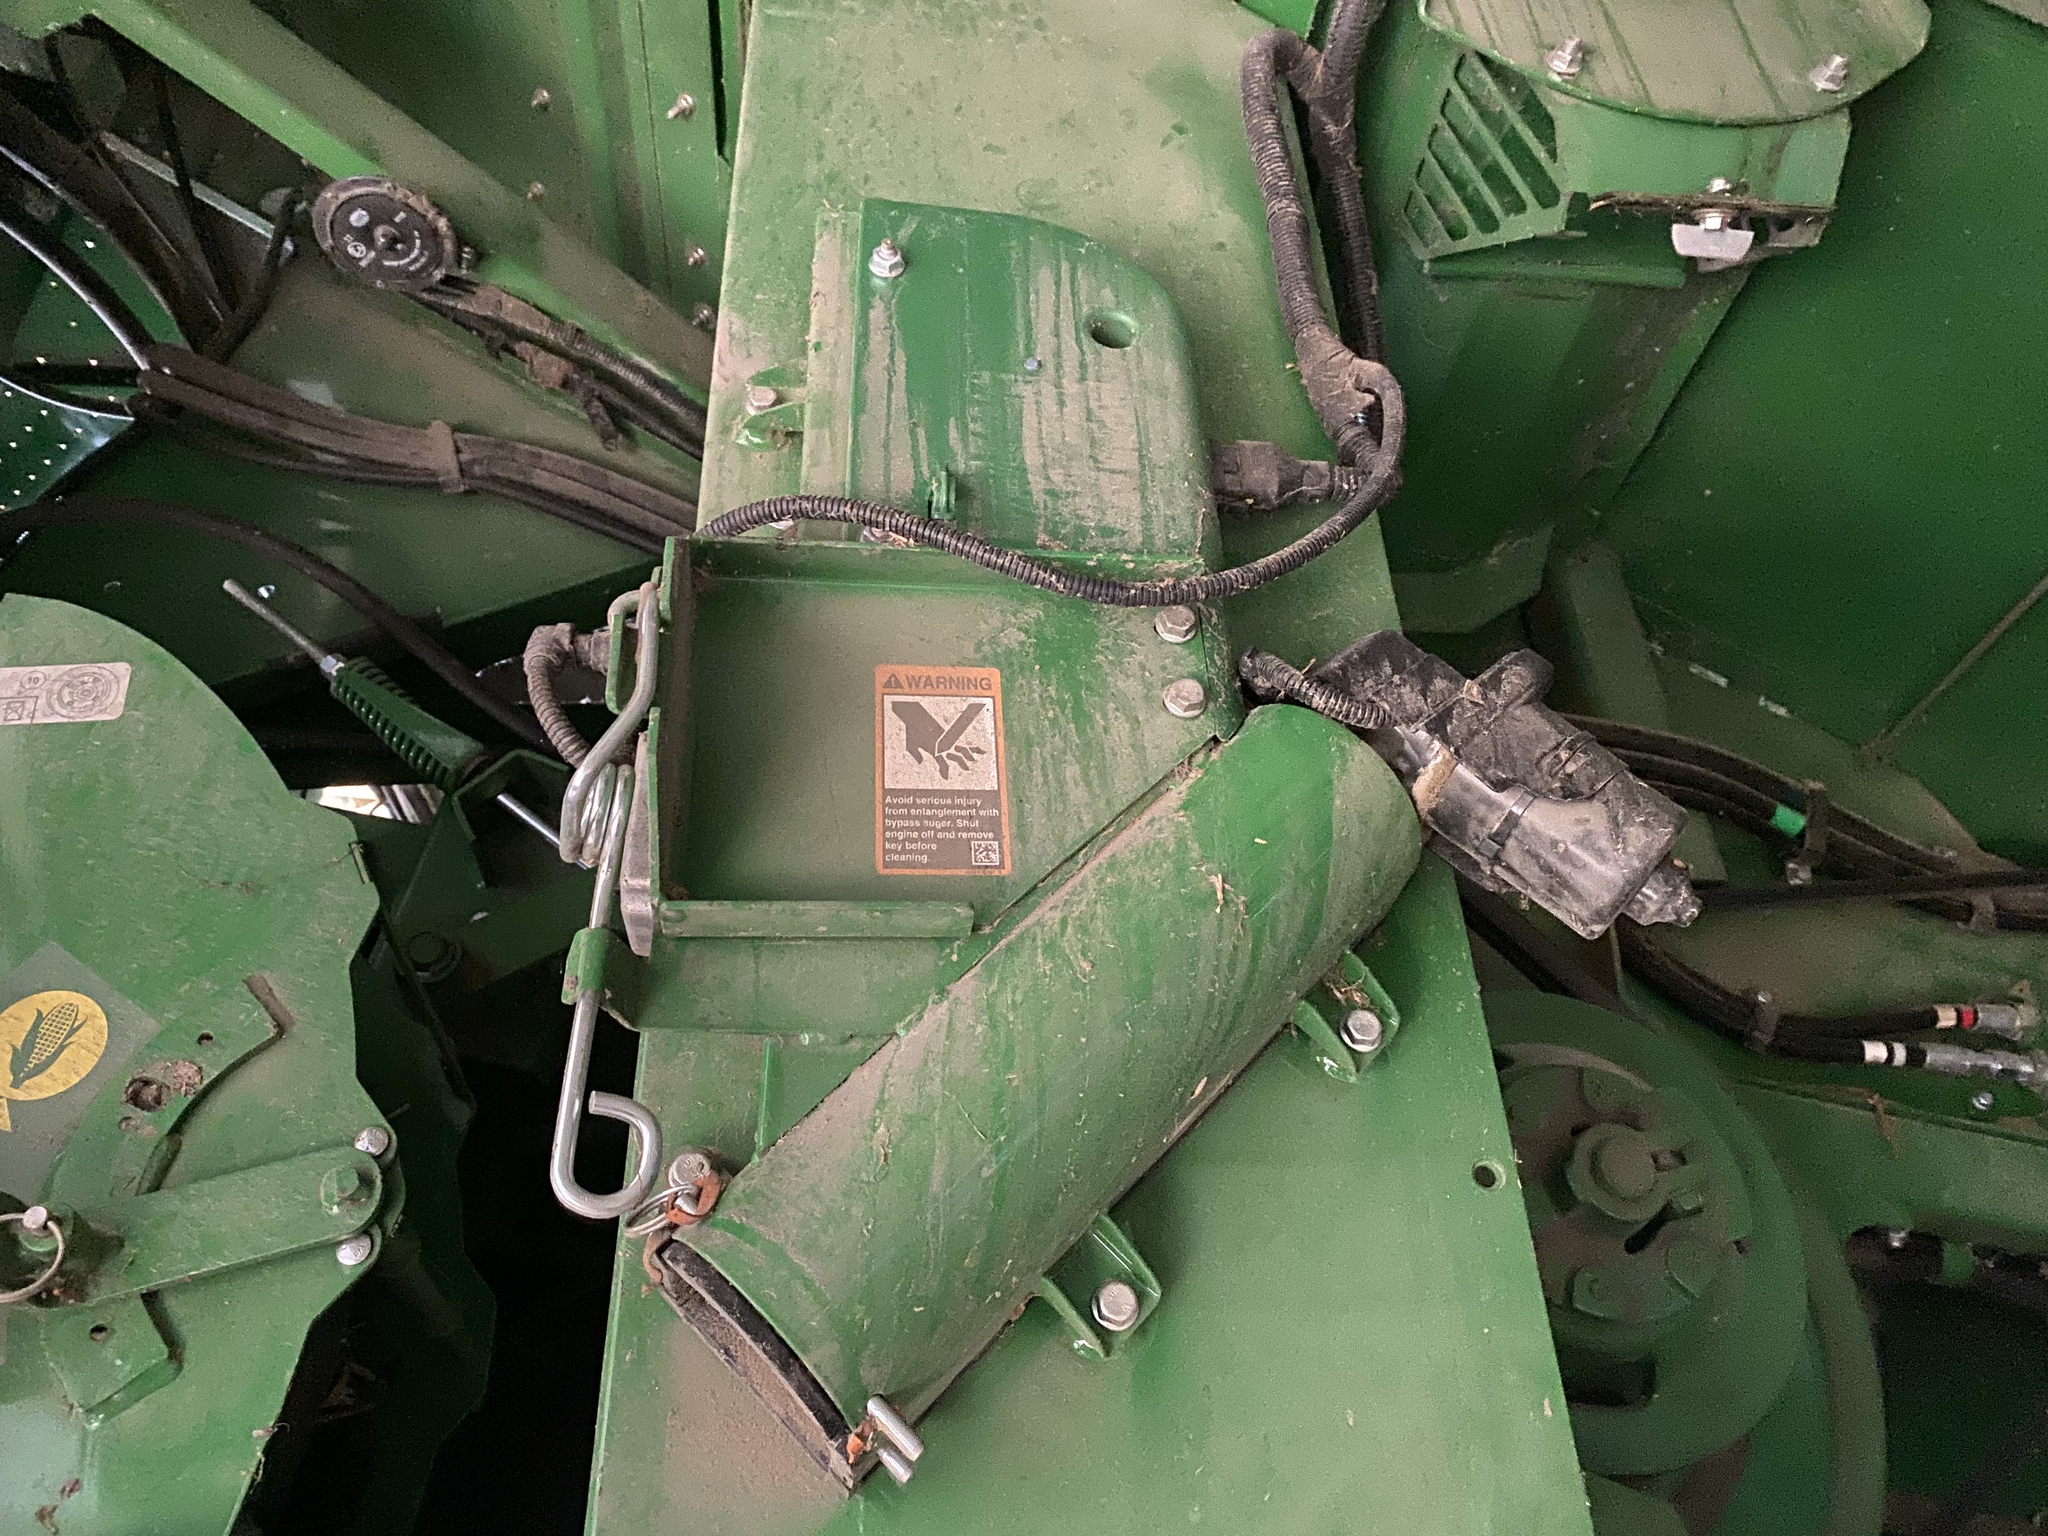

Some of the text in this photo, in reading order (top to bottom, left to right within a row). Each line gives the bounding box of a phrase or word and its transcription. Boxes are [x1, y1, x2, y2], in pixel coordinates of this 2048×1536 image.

[28, 676, 39, 685] 10
[904, 674, 992, 690] WARNING
[885, 795, 982, 807] Avoid serious injury
[885, 807, 999, 817] from entanglement with
[885, 818, 921, 828] bypass
[956, 819, 979, 828] Shut
[885, 830, 994, 840] engine off and remove
[885, 841, 938, 851] key before
[885, 853, 930, 863] cleaning.
